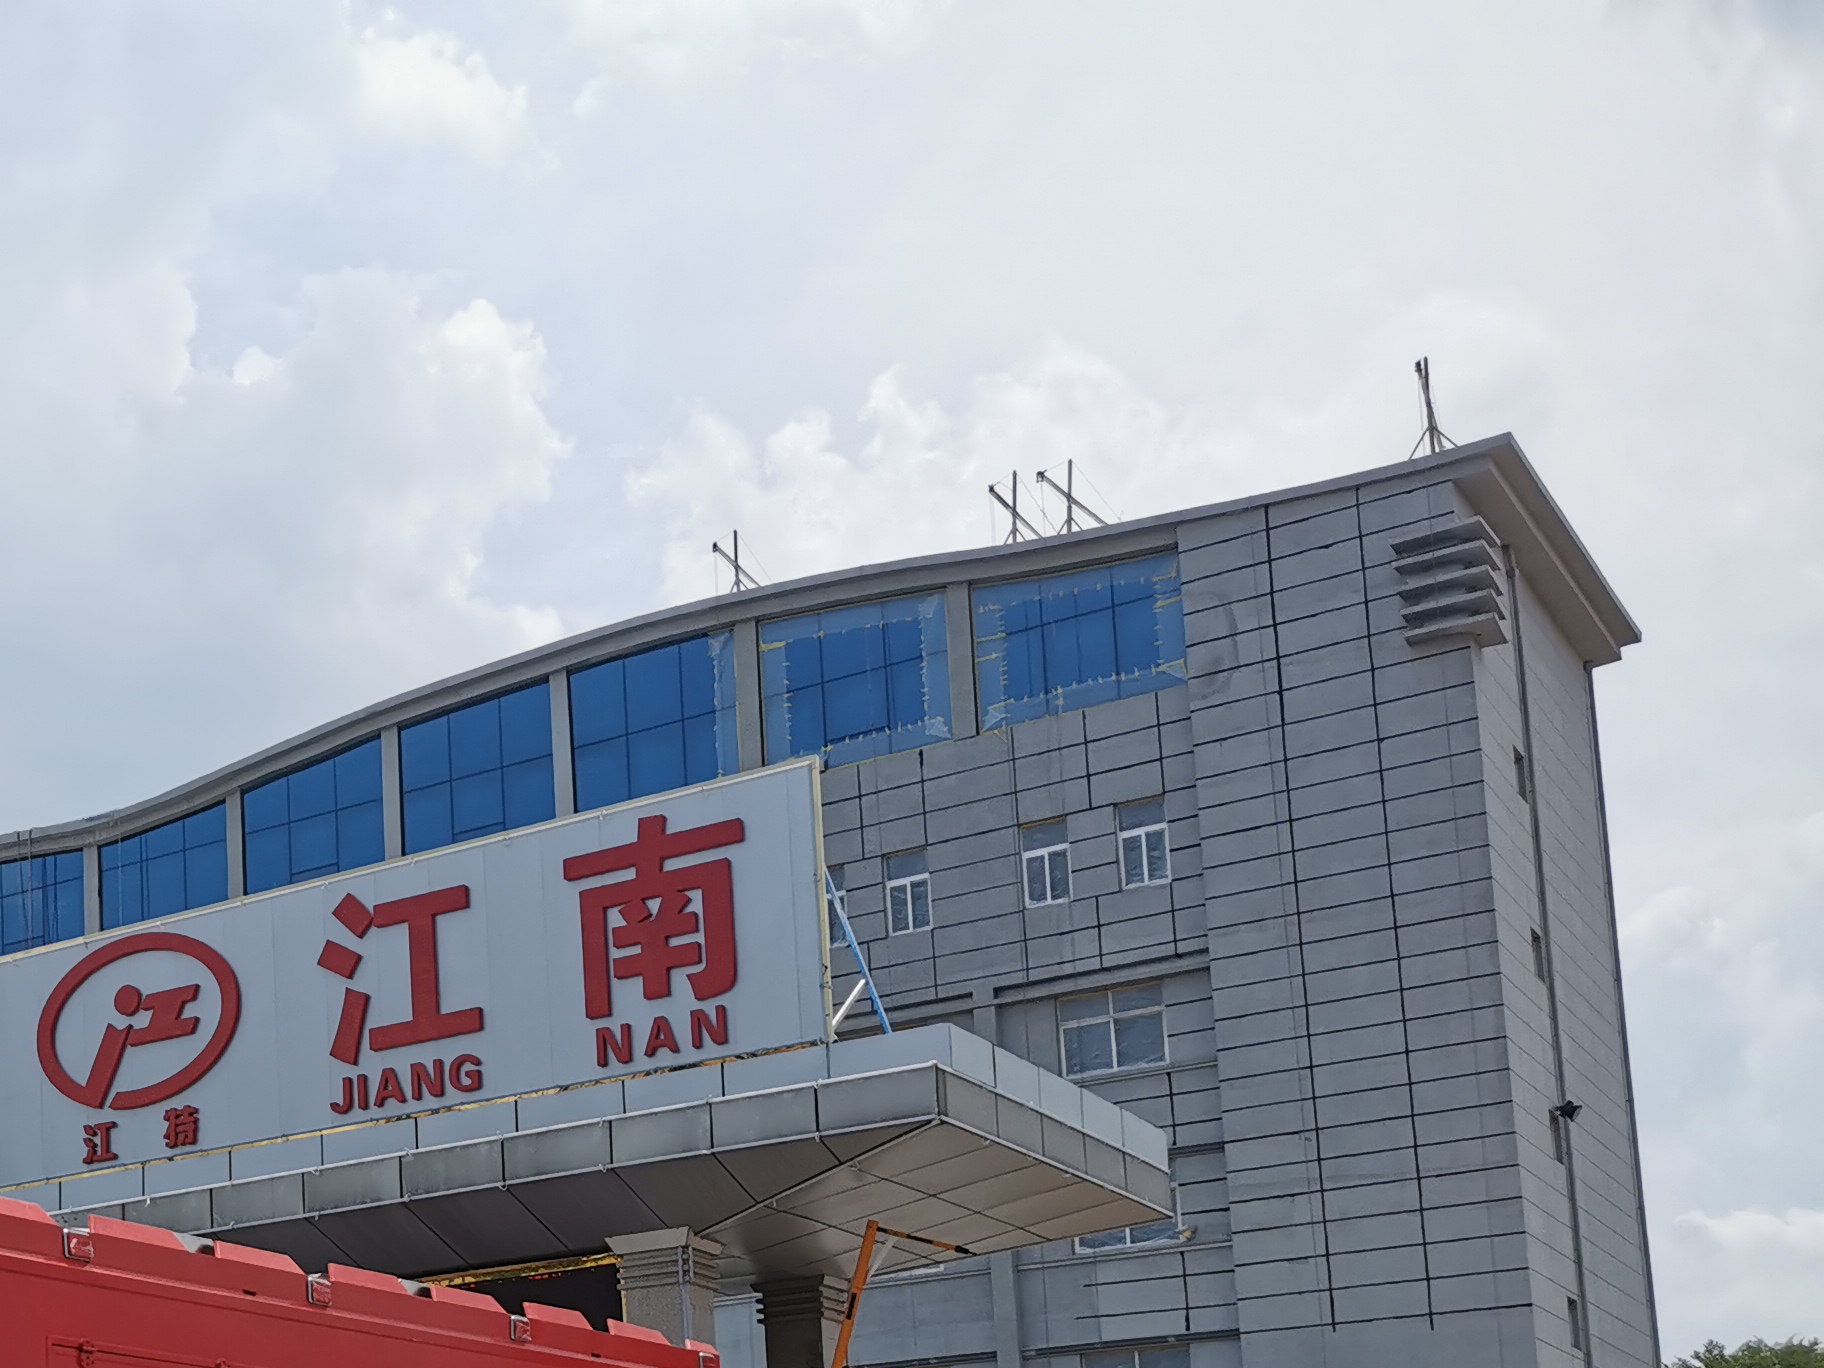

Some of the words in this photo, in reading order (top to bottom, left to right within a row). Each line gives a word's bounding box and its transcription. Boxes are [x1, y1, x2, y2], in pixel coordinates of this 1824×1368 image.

[317, 814, 745, 1066] 江南
[329, 1053, 483, 1115] JIANG
[594, 1004, 730, 1068] NAN
[82, 1104, 200, 1165] 江特
